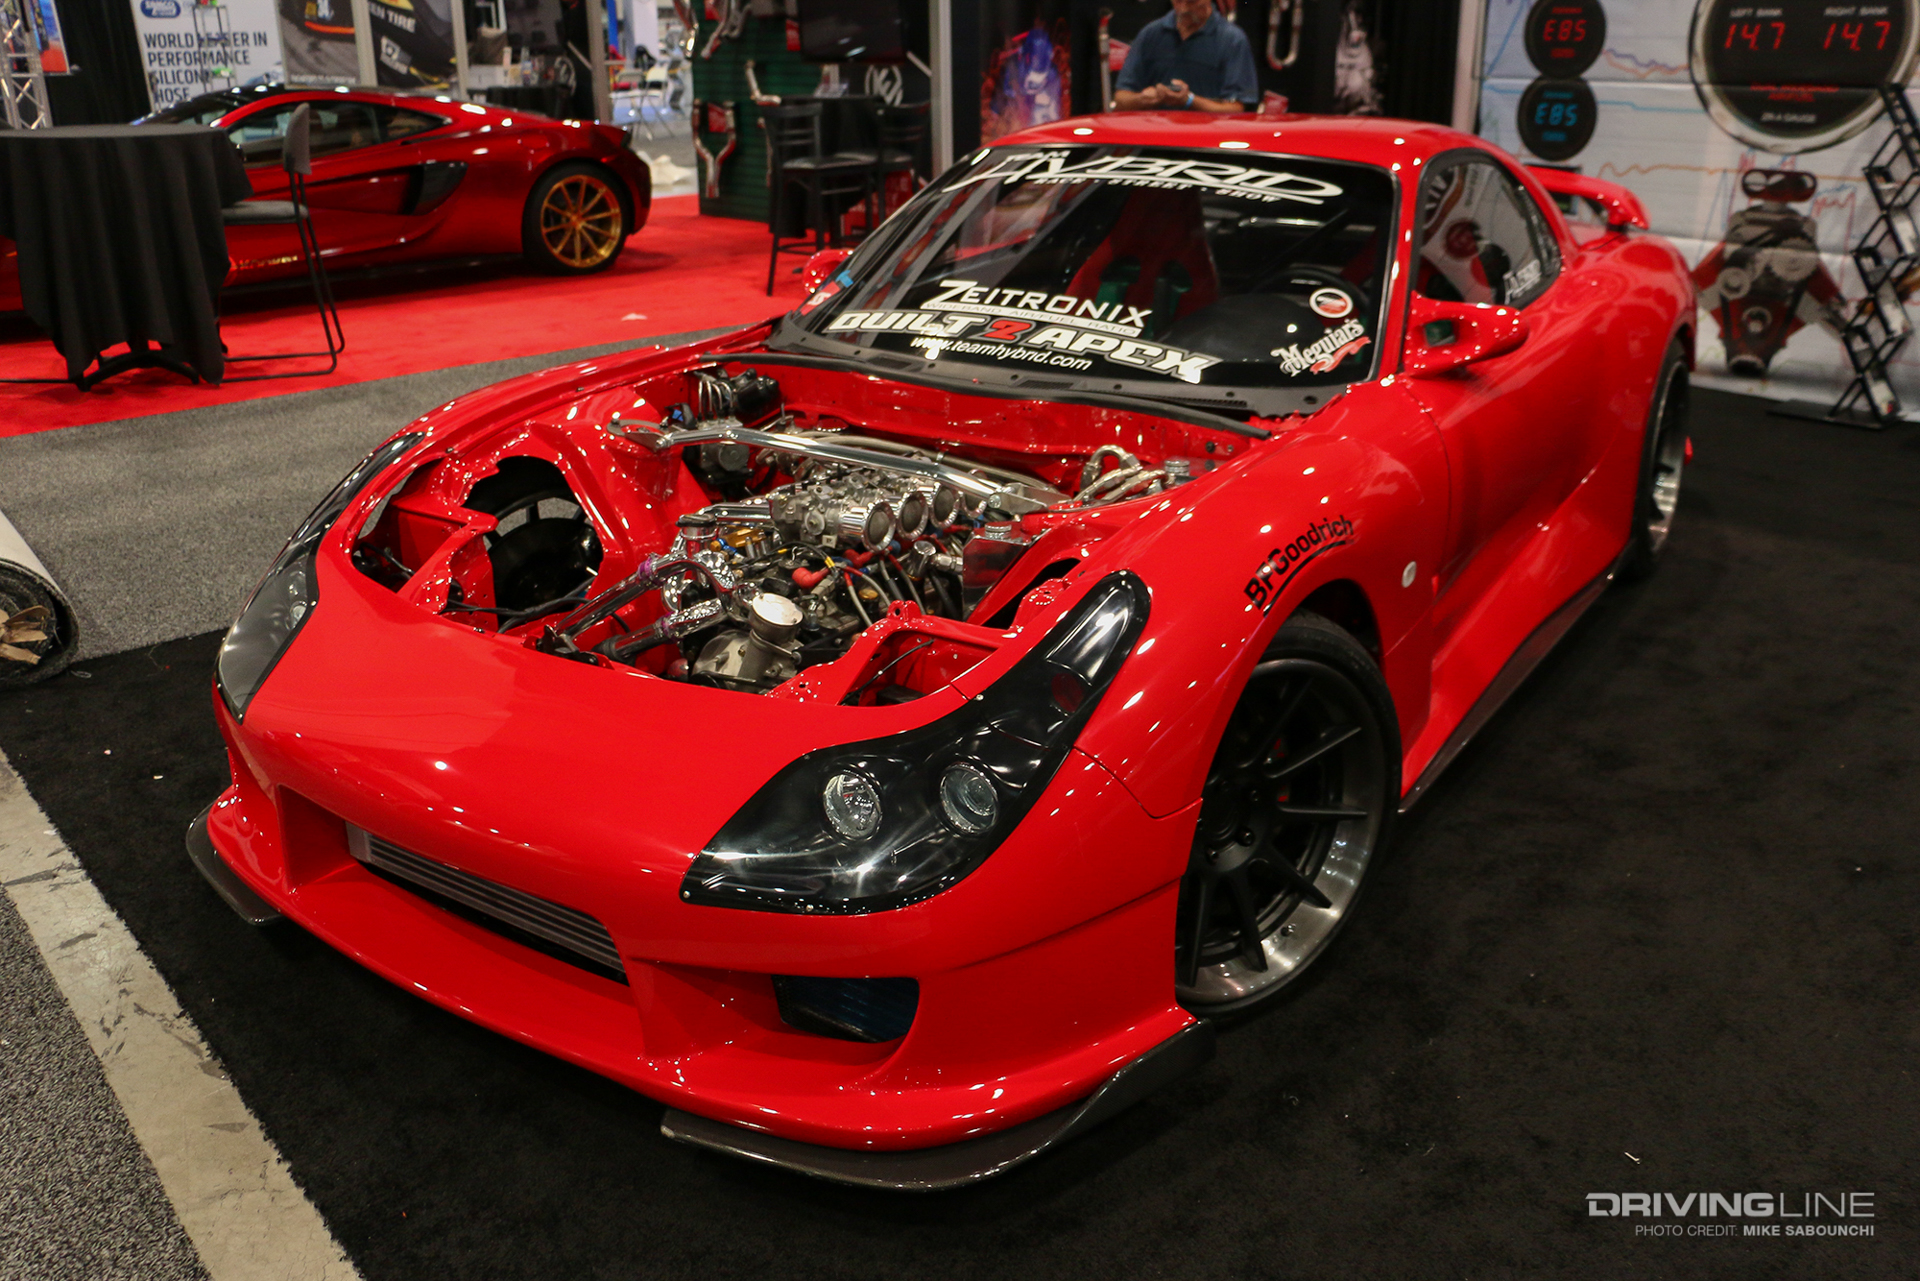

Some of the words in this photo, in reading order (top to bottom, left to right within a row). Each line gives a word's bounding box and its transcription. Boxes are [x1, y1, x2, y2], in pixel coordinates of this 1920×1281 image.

[387, 9, 416, 33] TIRE
[1543, 19, 1587, 41] E85
[144, 32, 194, 48] WORLD
[253, 31, 268, 47] IN
[147, 50, 251, 67] PERFORMANCE
[1535, 102, 1578, 126] E85
[1004, 150, 1070, 163] TEAM
[1033, 177, 1087, 185] RACE
[1107, 178, 1193, 190] STREET
[1215, 188, 1282, 203] SHOW
[927, 279, 1154, 328] ZEITRONIX
[926, 302, 1002, 315] WIDEBAND
[1009, 309, 1076, 324] AIR/FUEL
[1087, 321, 1137, 335] RATIO
[828, 310, 988, 337] BUILT
[982, 318, 1032, 342] 2
[1027, 326, 1214, 384] APEX
[910, 336, 1093, 371] www.teamhybrid.com
[1270, 318, 1365, 377] Meguiar's
[1243, 514, 1354, 610] BFGoodrich
